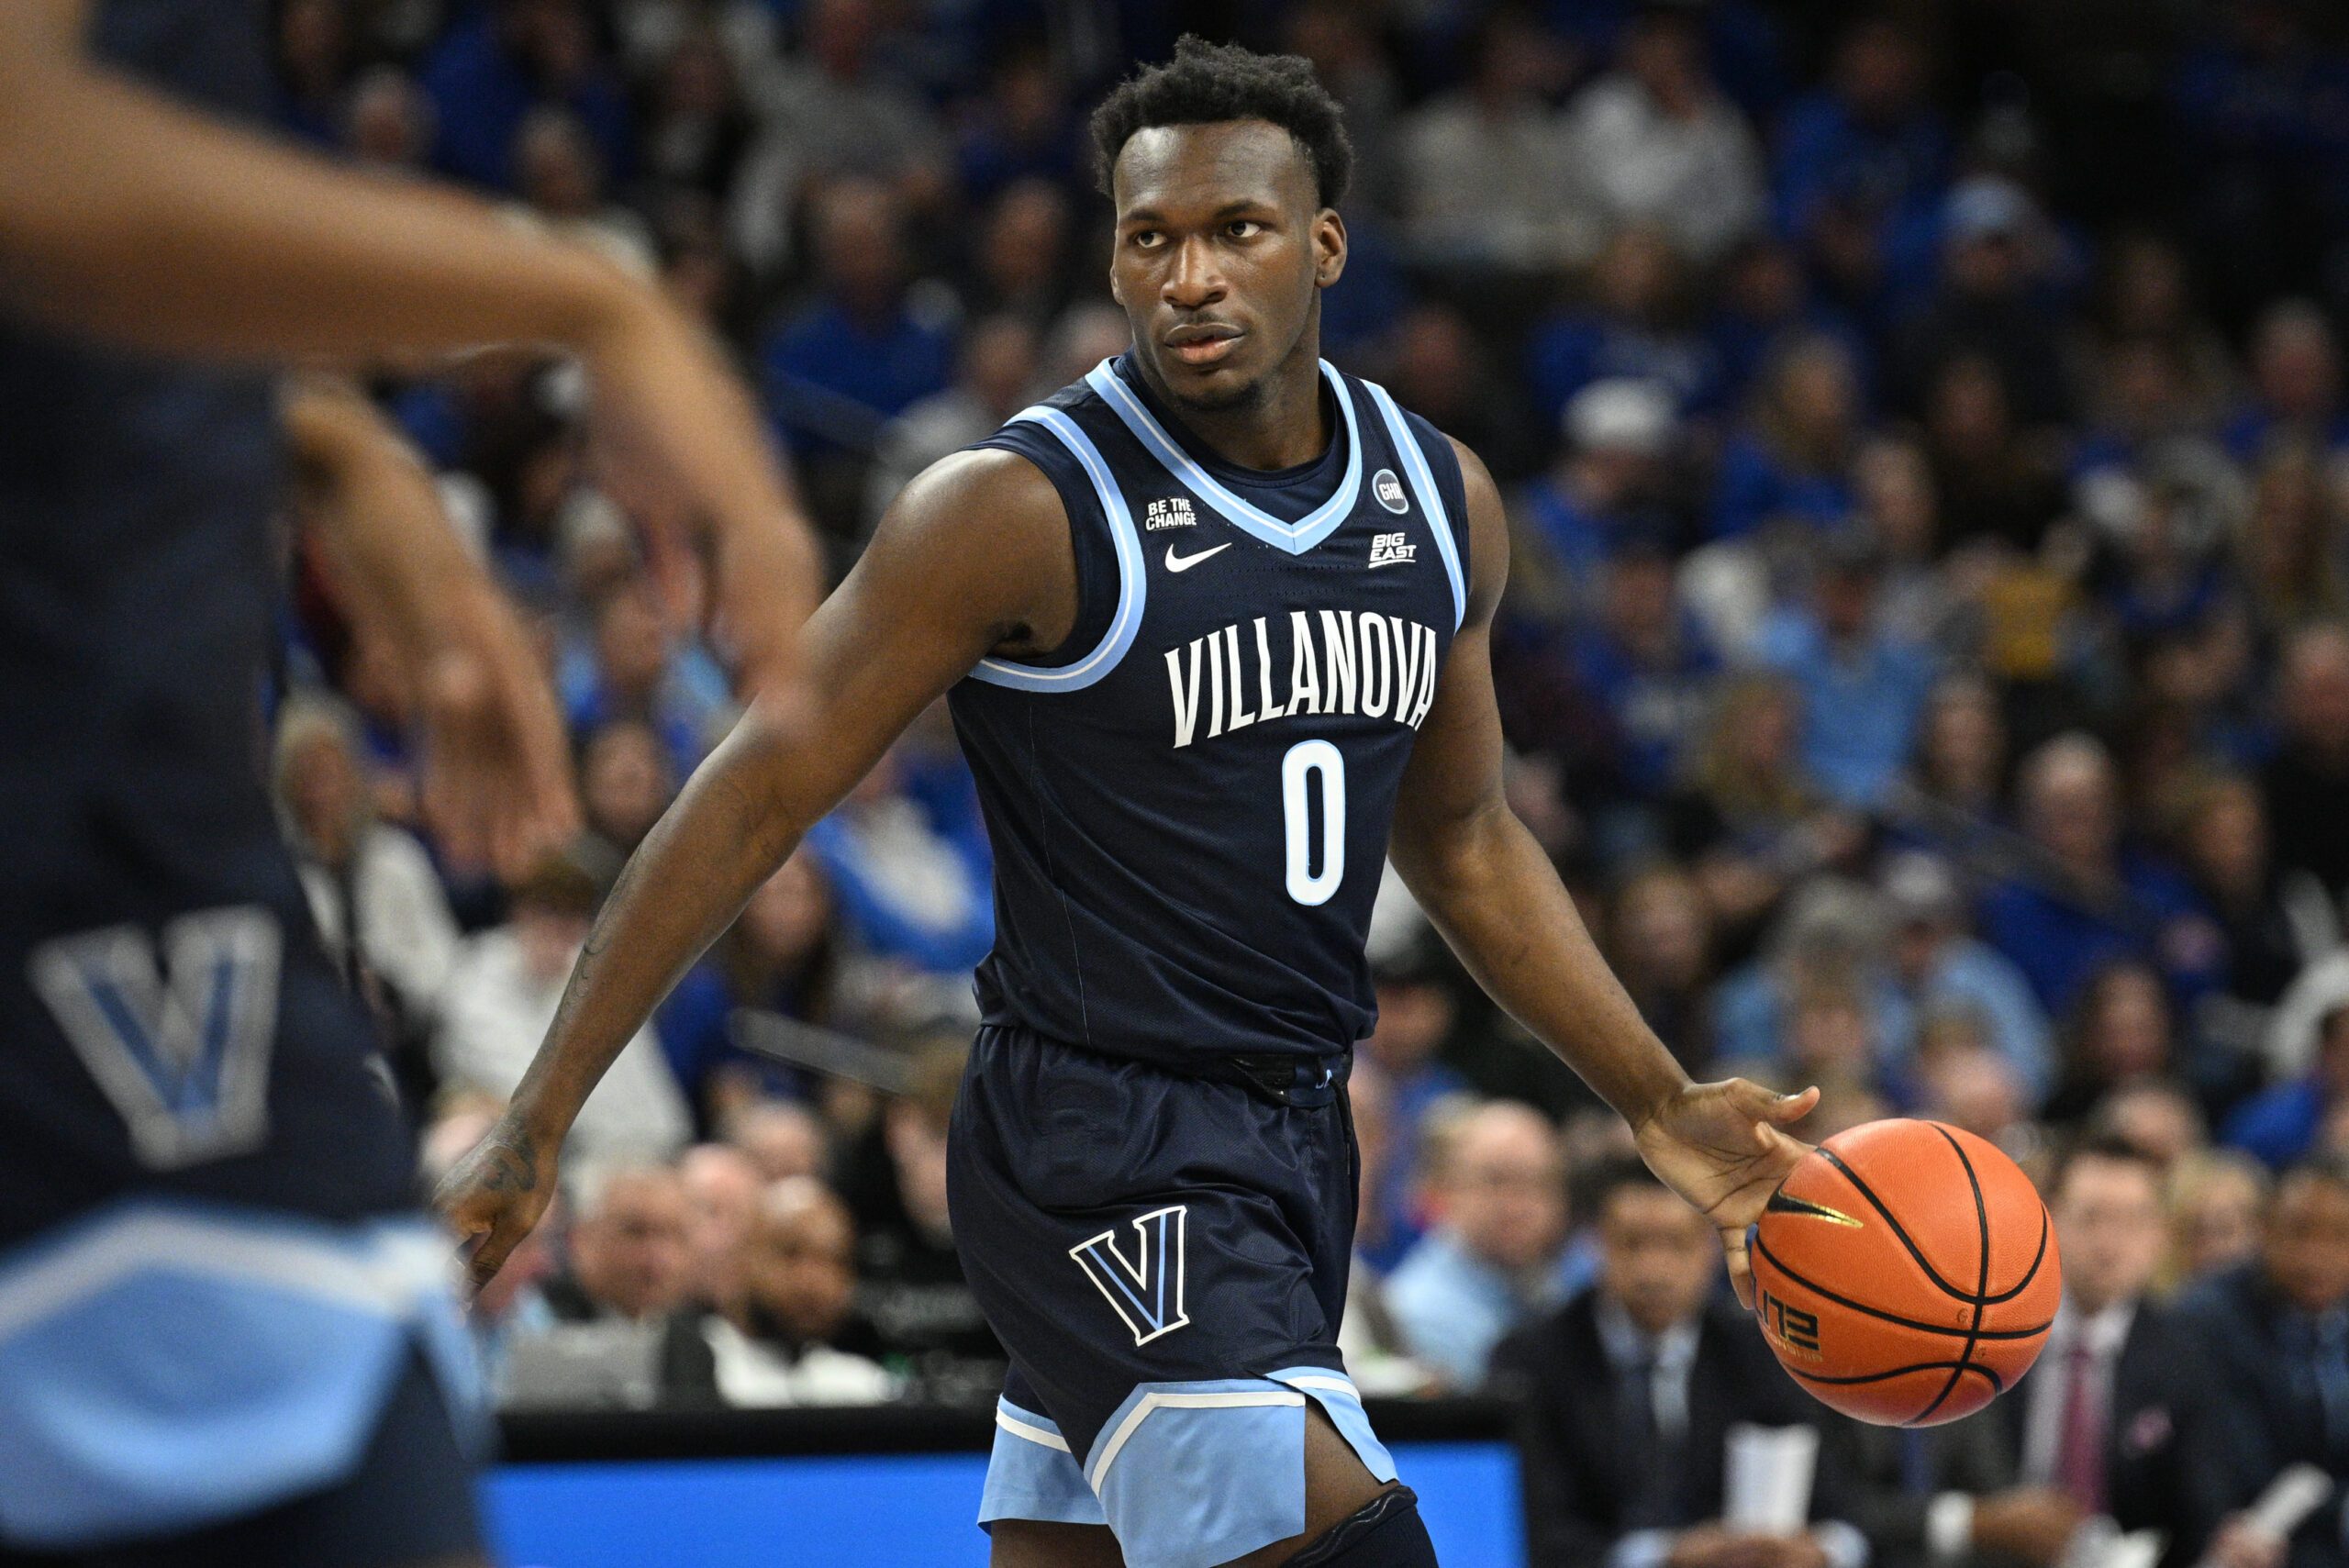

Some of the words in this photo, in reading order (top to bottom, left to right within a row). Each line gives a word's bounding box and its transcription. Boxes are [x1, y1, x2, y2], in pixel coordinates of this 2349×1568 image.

[1145, 511, 1197, 531] CHANGE
[1148, 499, 1167, 517] BE
[1170, 497, 1192, 512] THE
[1372, 532, 1406, 549] BIG
[1369, 544, 1418, 562] EAST
[1163, 609, 1437, 750] VILLANOVA
[1281, 739, 1346, 906] 0
[27, 903, 284, 1172] V
[1068, 1205, 1190, 1347] V
